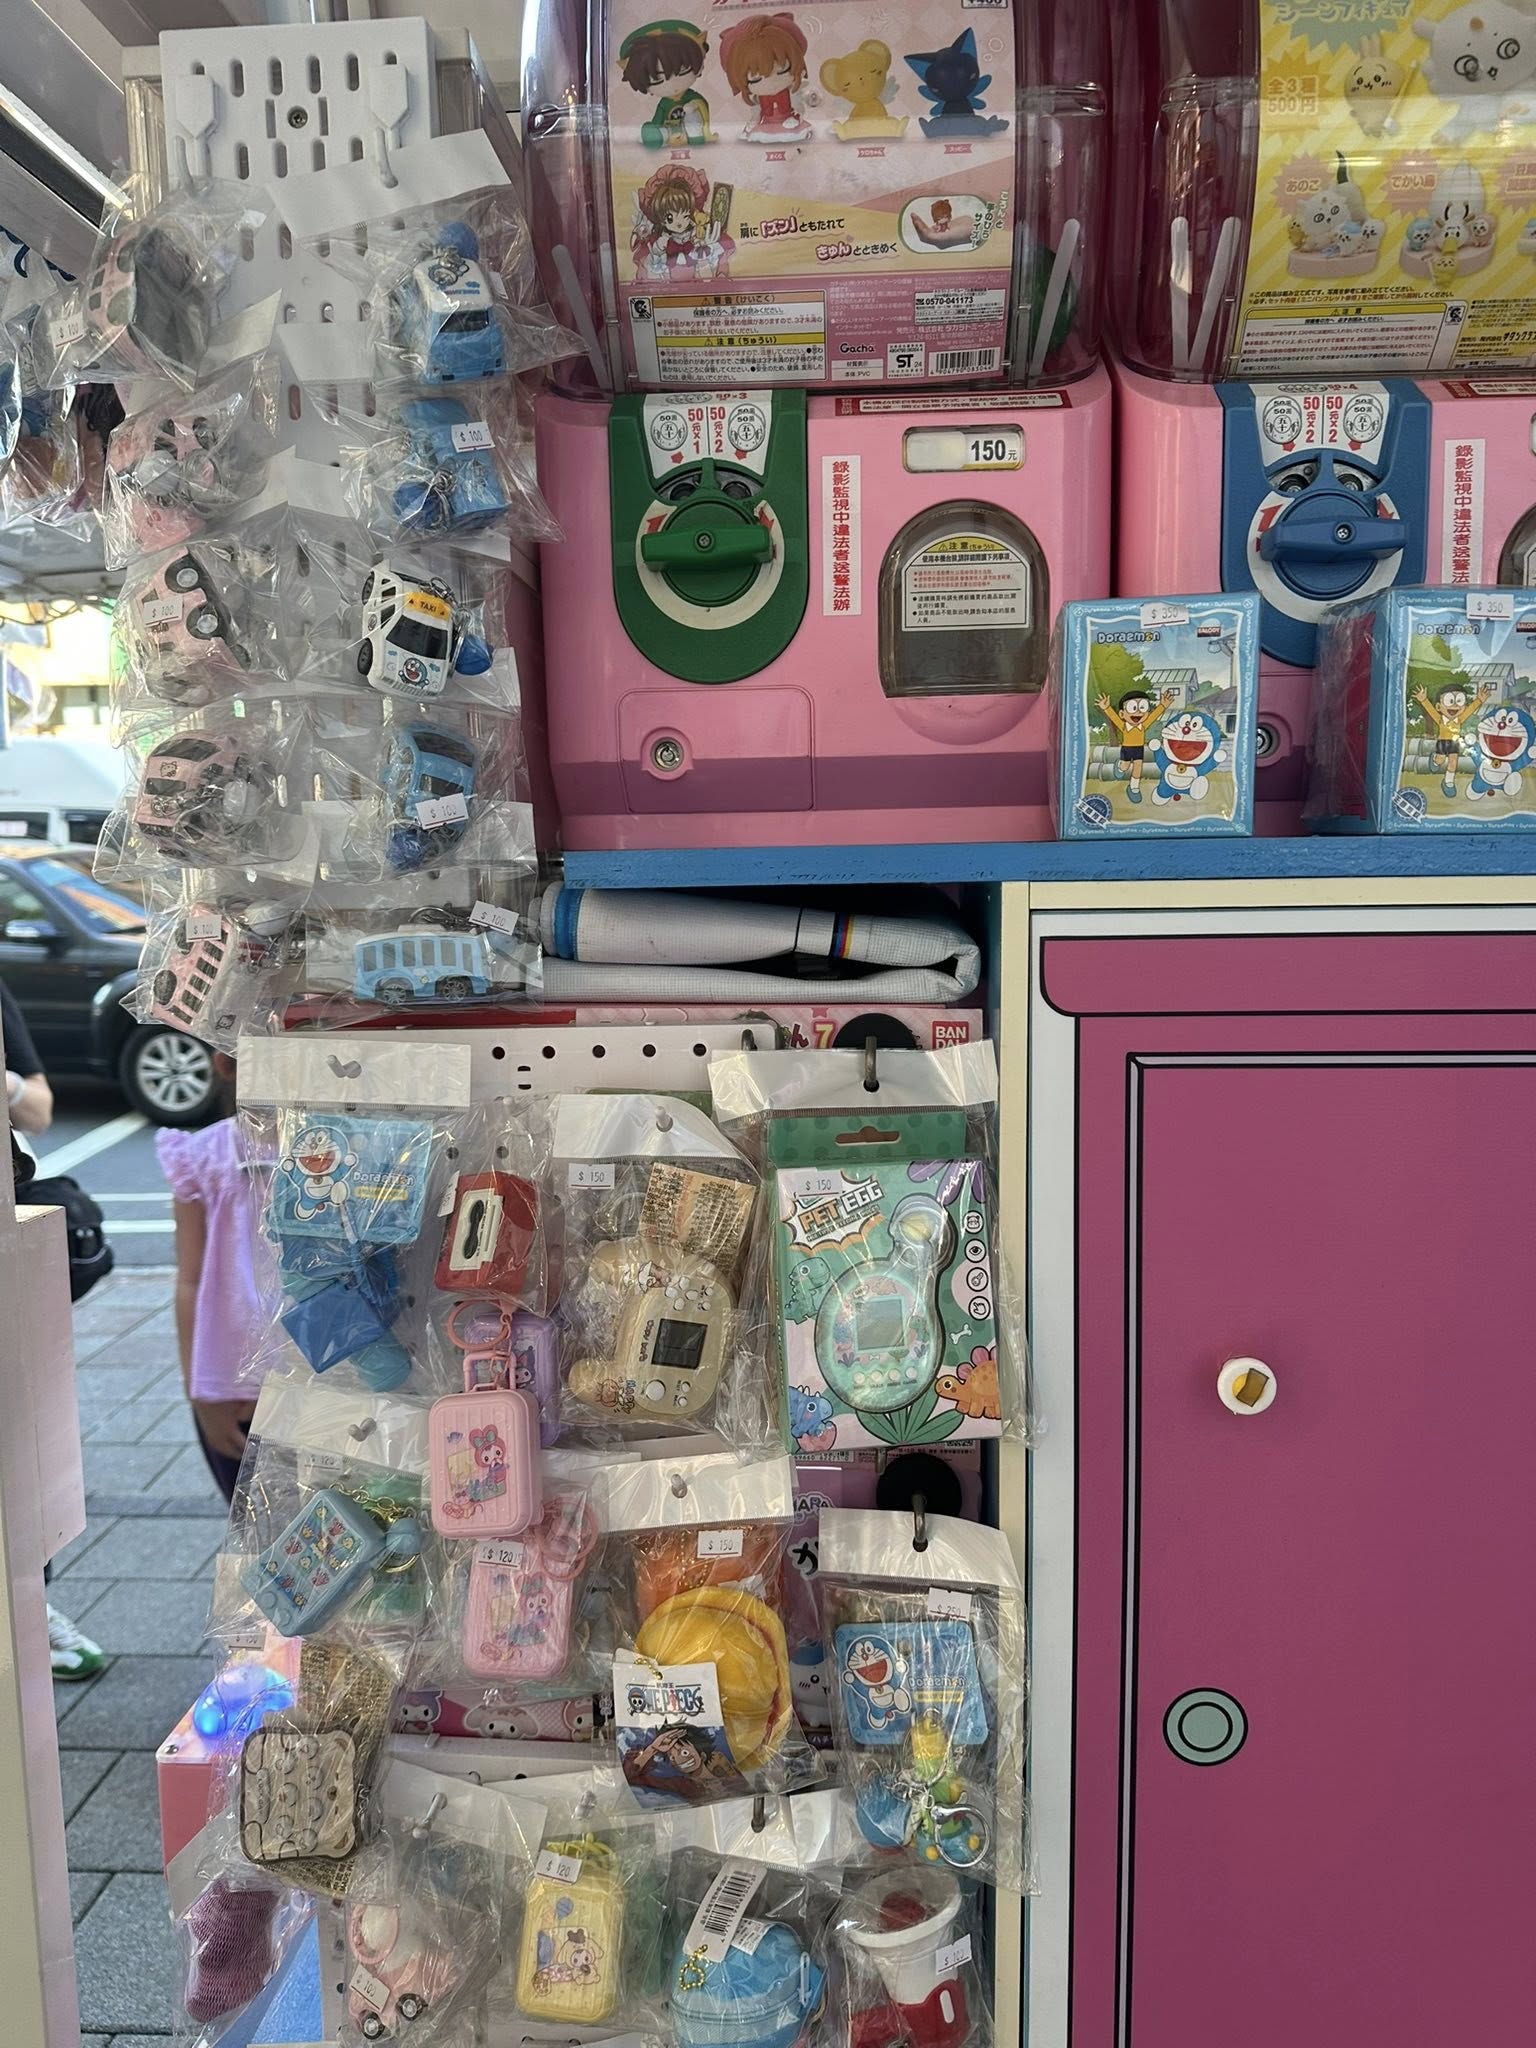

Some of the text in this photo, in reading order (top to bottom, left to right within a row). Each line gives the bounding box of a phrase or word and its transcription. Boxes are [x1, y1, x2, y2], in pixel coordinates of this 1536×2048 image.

[1267, 96, 1317, 113] 500円
[1285, 178, 1320, 193] あのこ
[840, 343, 875, 354] Gacha
[896, 354, 914, 369] ST
[469, 429, 485, 442] 100
[831, 460, 851, 612] 錄影監視中違法者送警法辦
[419, 600, 437, 613] TAXI
[1161, 607, 1179, 619] 350
[1487, 601, 1504, 614] 350
[1417, 623, 1480, 635] Doraemon
[1097, 630, 1161, 645] Doraemon
[442, 803, 458, 817] 100
[491, 912, 506, 926] 100
[815, 1024, 834, 1049] 7
[935, 1026, 967, 1038] BAN
[589, 1170, 606, 1183] 150
[816, 1178, 832, 1191] 150
[798, 1199, 840, 1234] PET
[840, 1181, 885, 1214] EGG
[718, 1538, 734, 1553] 150
[499, 1549, 514, 1563] 120
[946, 1605, 962, 1618] 250
[908, 1675, 968, 1689] Doraemon
[556, 1862, 571, 1877] 120
[363, 1979, 378, 1998] 100
